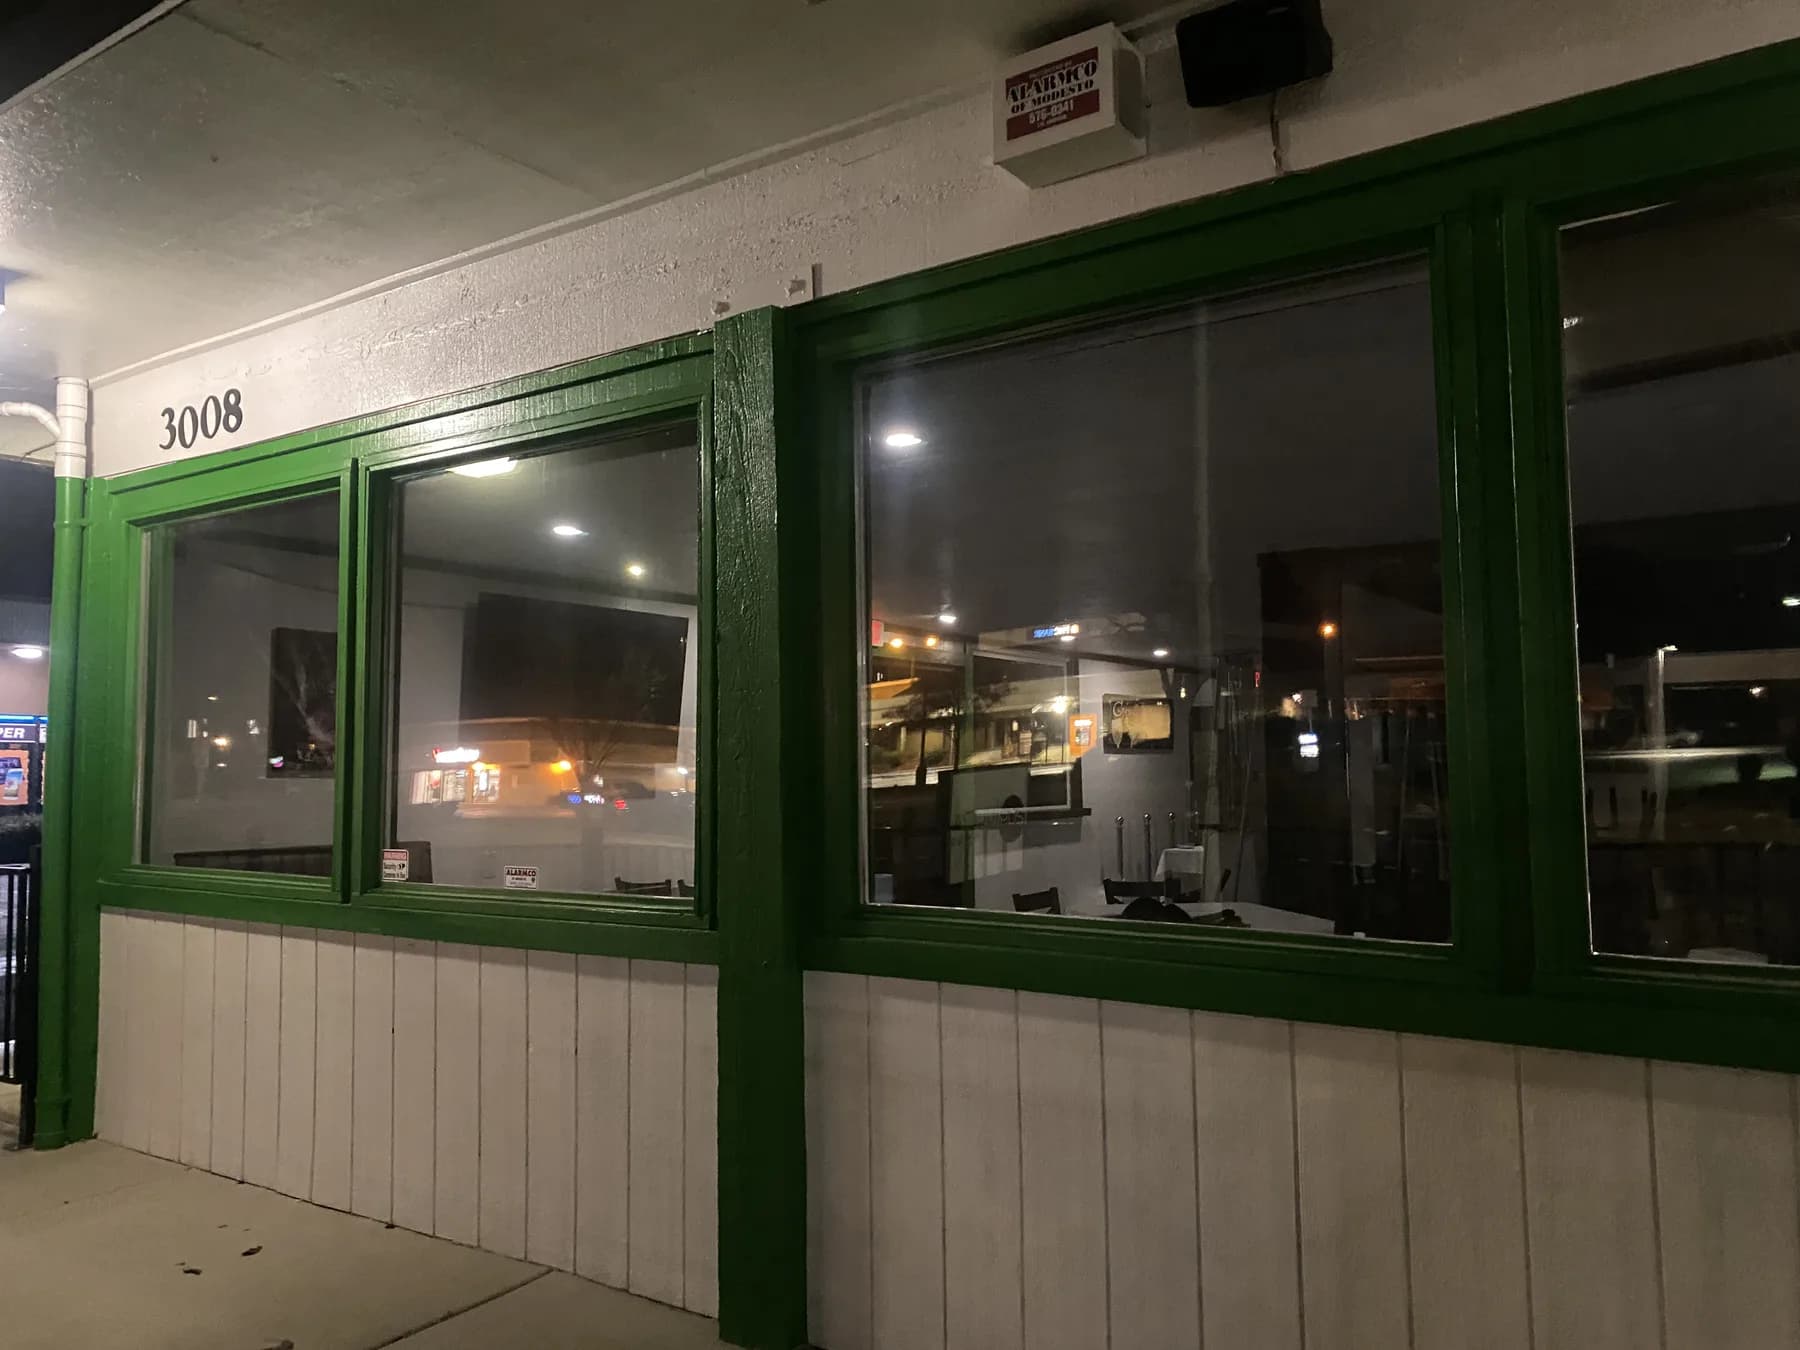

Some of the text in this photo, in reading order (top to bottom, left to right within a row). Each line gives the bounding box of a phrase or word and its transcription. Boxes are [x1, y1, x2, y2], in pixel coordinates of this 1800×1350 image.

[1008, 60, 1097, 103] ALARMCO
[1011, 79, 1095, 115] OF MODESTO
[159, 388, 243, 450] 3008
